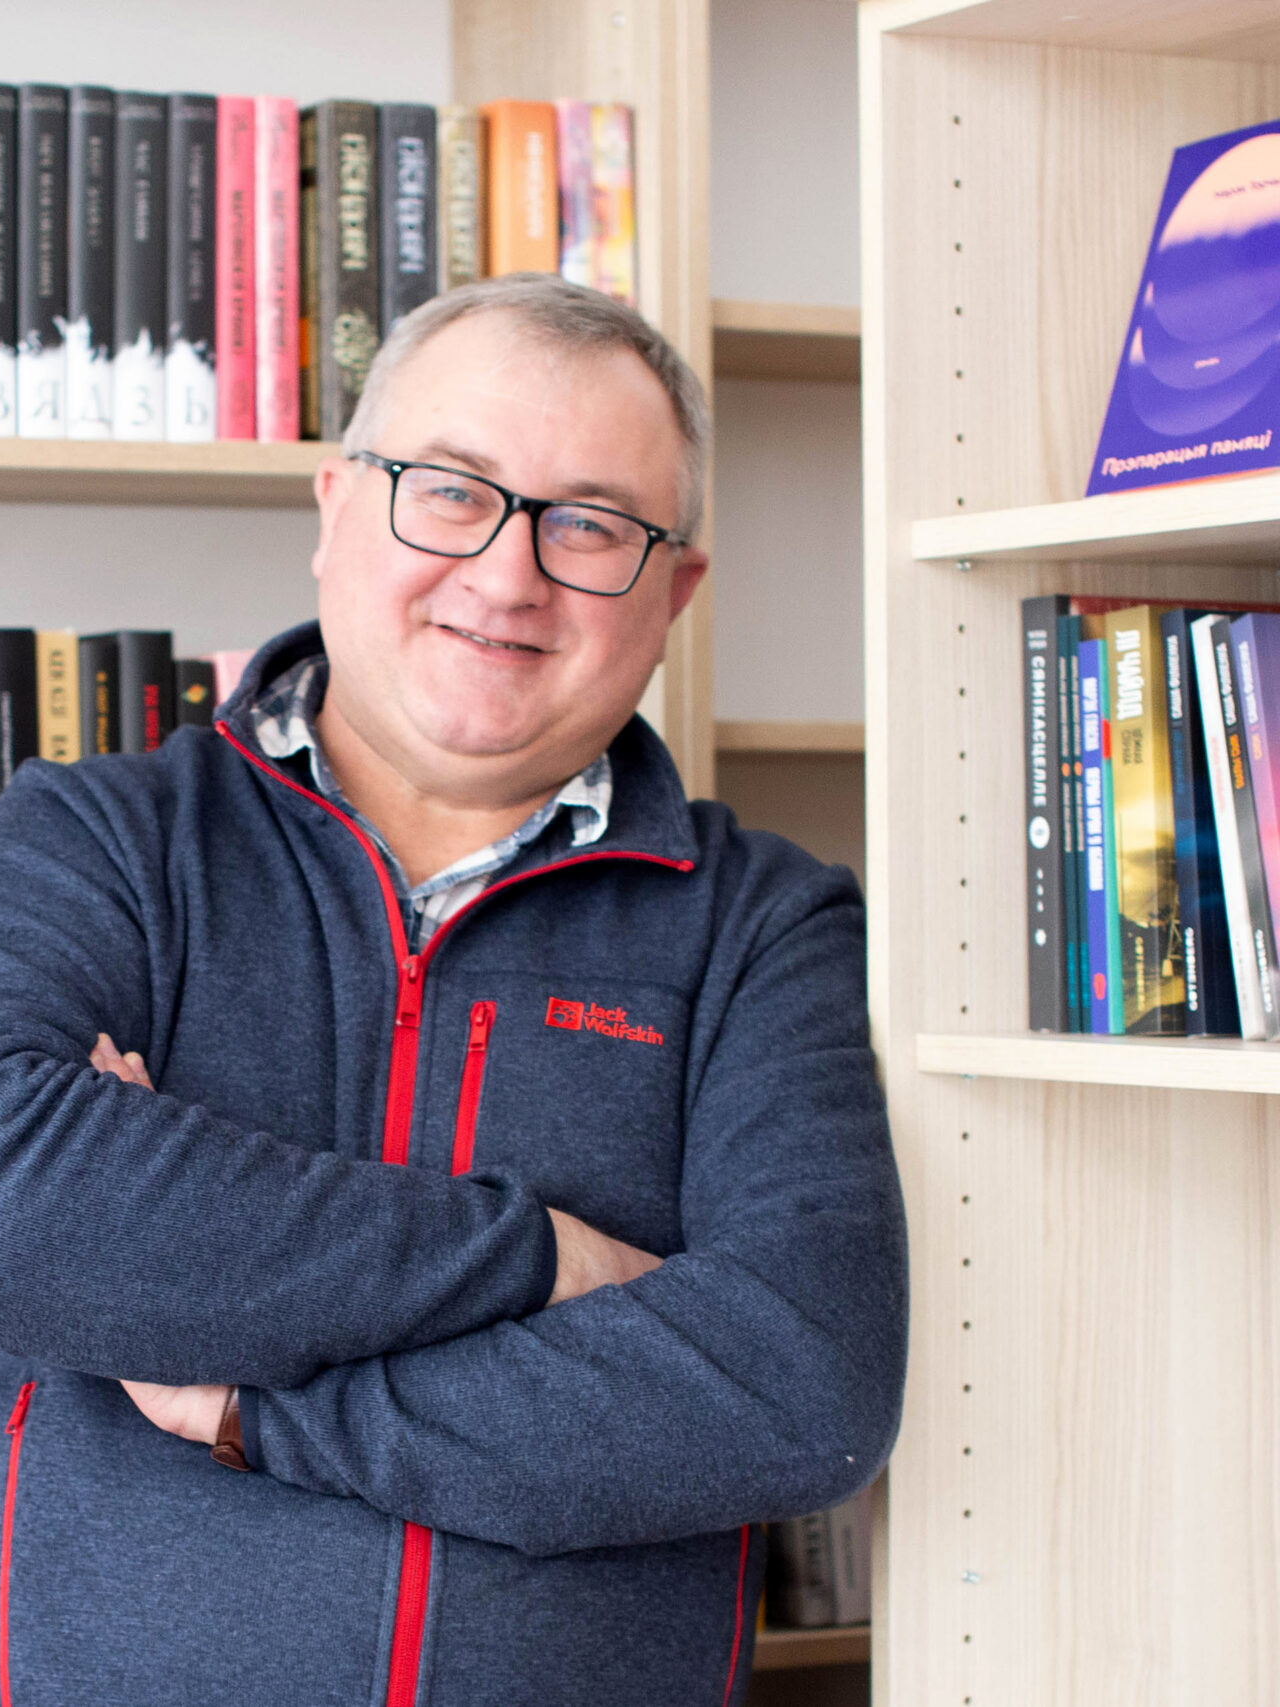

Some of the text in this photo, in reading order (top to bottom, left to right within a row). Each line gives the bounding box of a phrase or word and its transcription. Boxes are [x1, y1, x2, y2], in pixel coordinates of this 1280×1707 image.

[1101, 429, 1273, 479] Прэпарацыя памяці
[584, 1002, 628, 1023] Jack
[584, 1015, 664, 1046] Wolfskin
